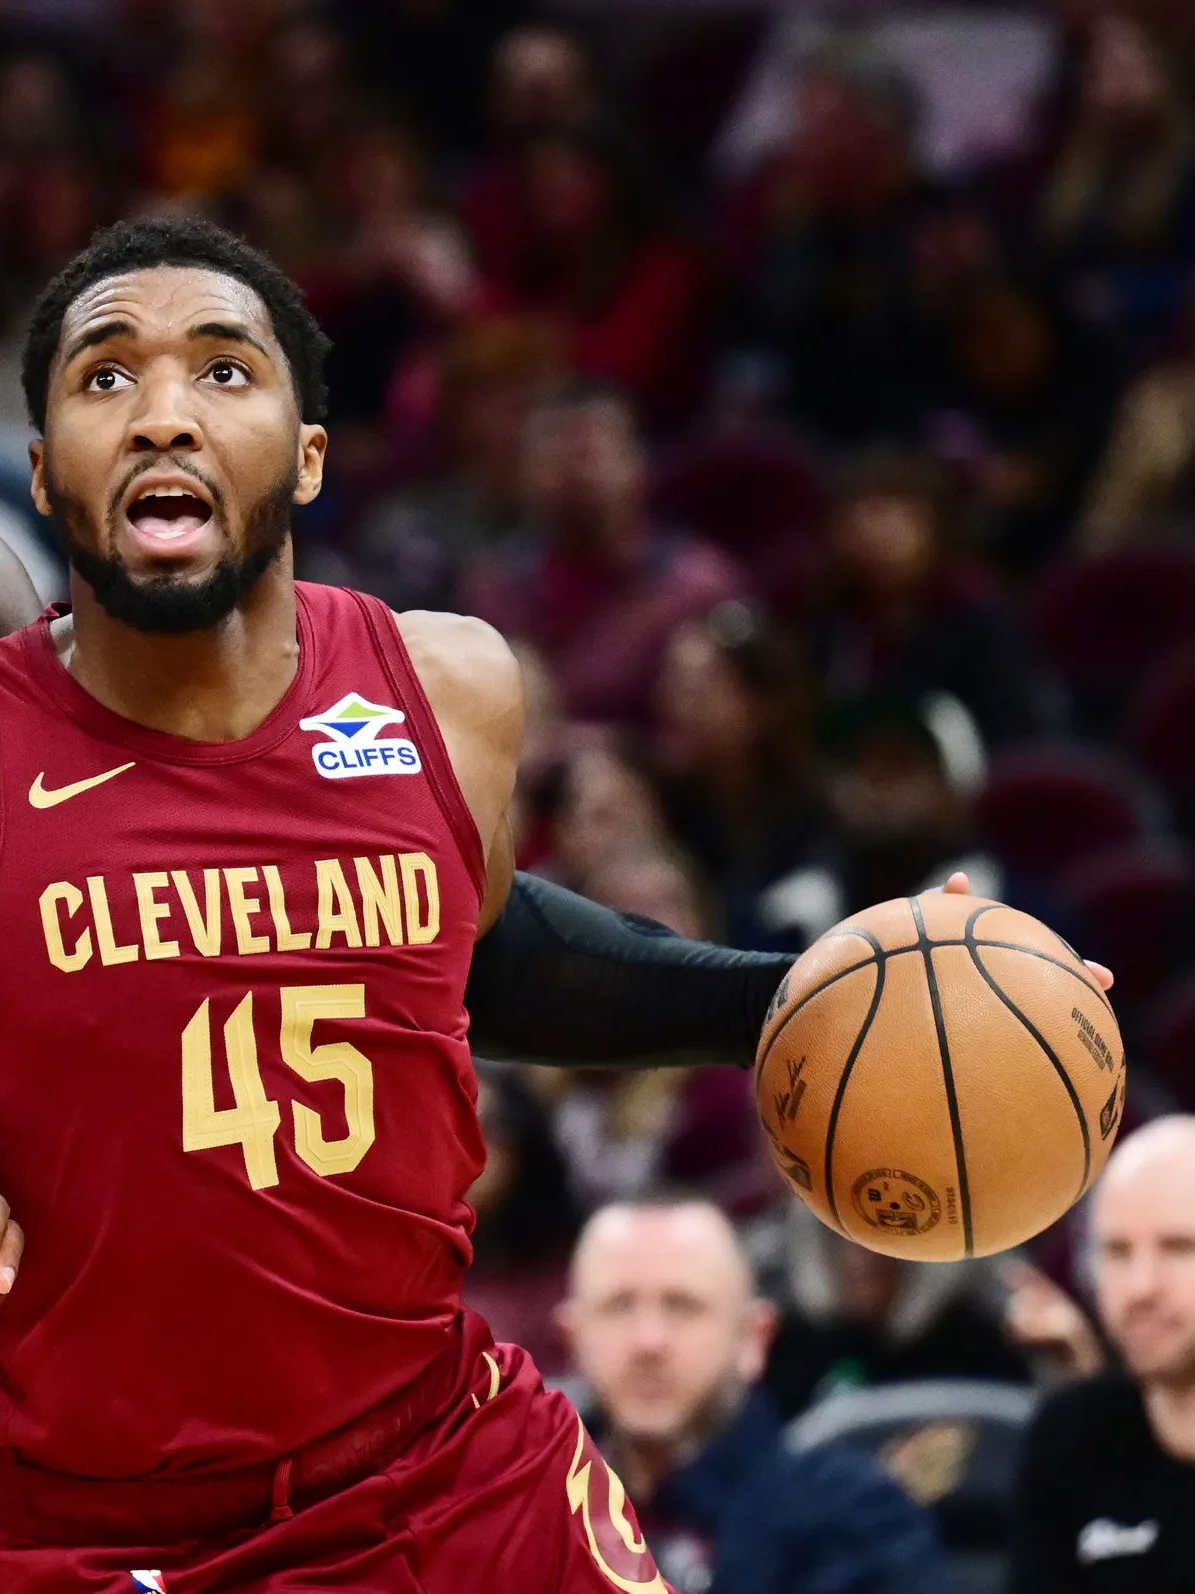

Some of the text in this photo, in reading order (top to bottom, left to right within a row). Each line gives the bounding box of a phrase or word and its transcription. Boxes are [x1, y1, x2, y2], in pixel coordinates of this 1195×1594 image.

[317, 747, 417, 770] CLIFFS
[38, 852, 440, 973] CLEVELAND
[181, 983, 376, 1191] 45
